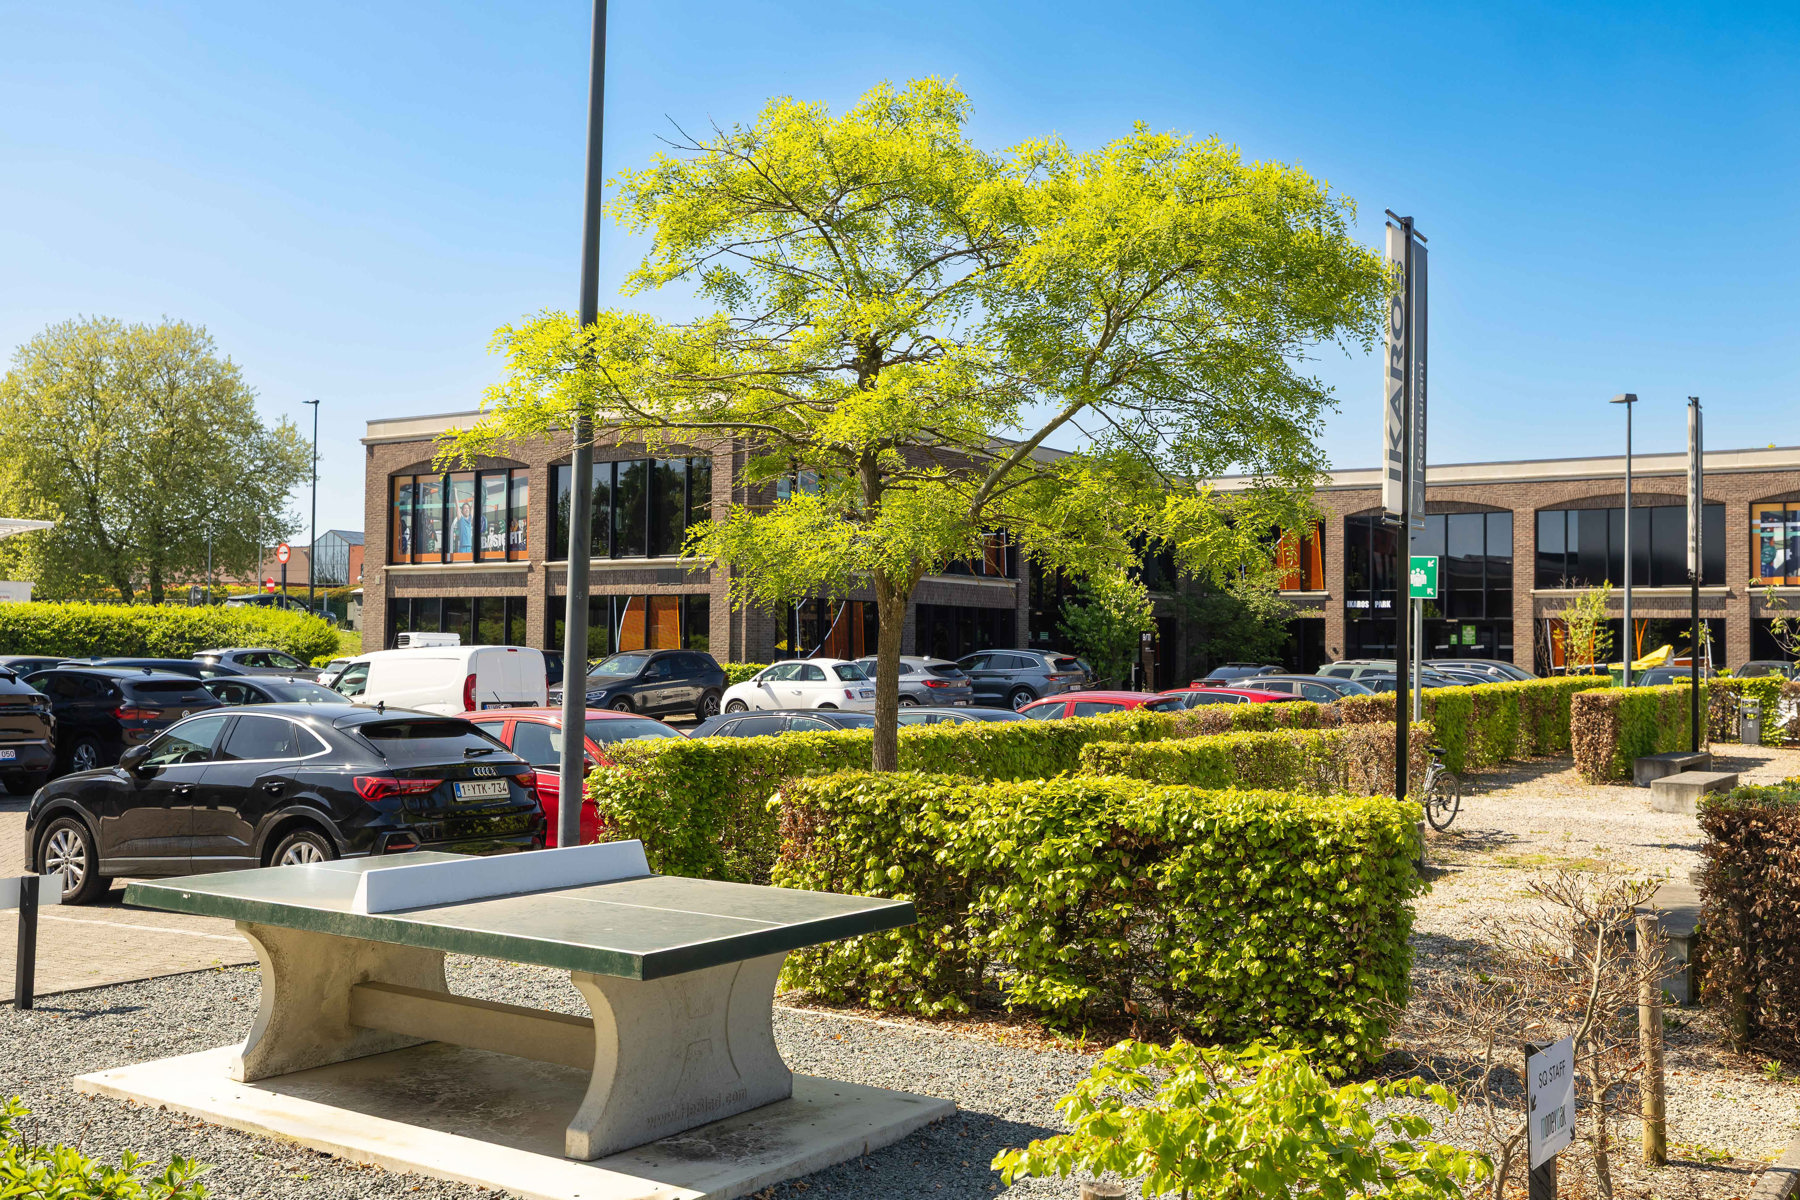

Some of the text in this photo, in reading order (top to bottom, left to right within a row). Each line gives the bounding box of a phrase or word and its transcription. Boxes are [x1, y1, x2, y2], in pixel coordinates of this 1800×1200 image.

[1389, 259, 1404, 482] IKAROS
[1416, 361, 1425, 473] Restaurant
[1346, 600, 1391, 608] IKAROS PARK
[461, 782, 507, 796] 1-YTK-734
[1538, 1060, 1566, 1089] SQ STAFF
